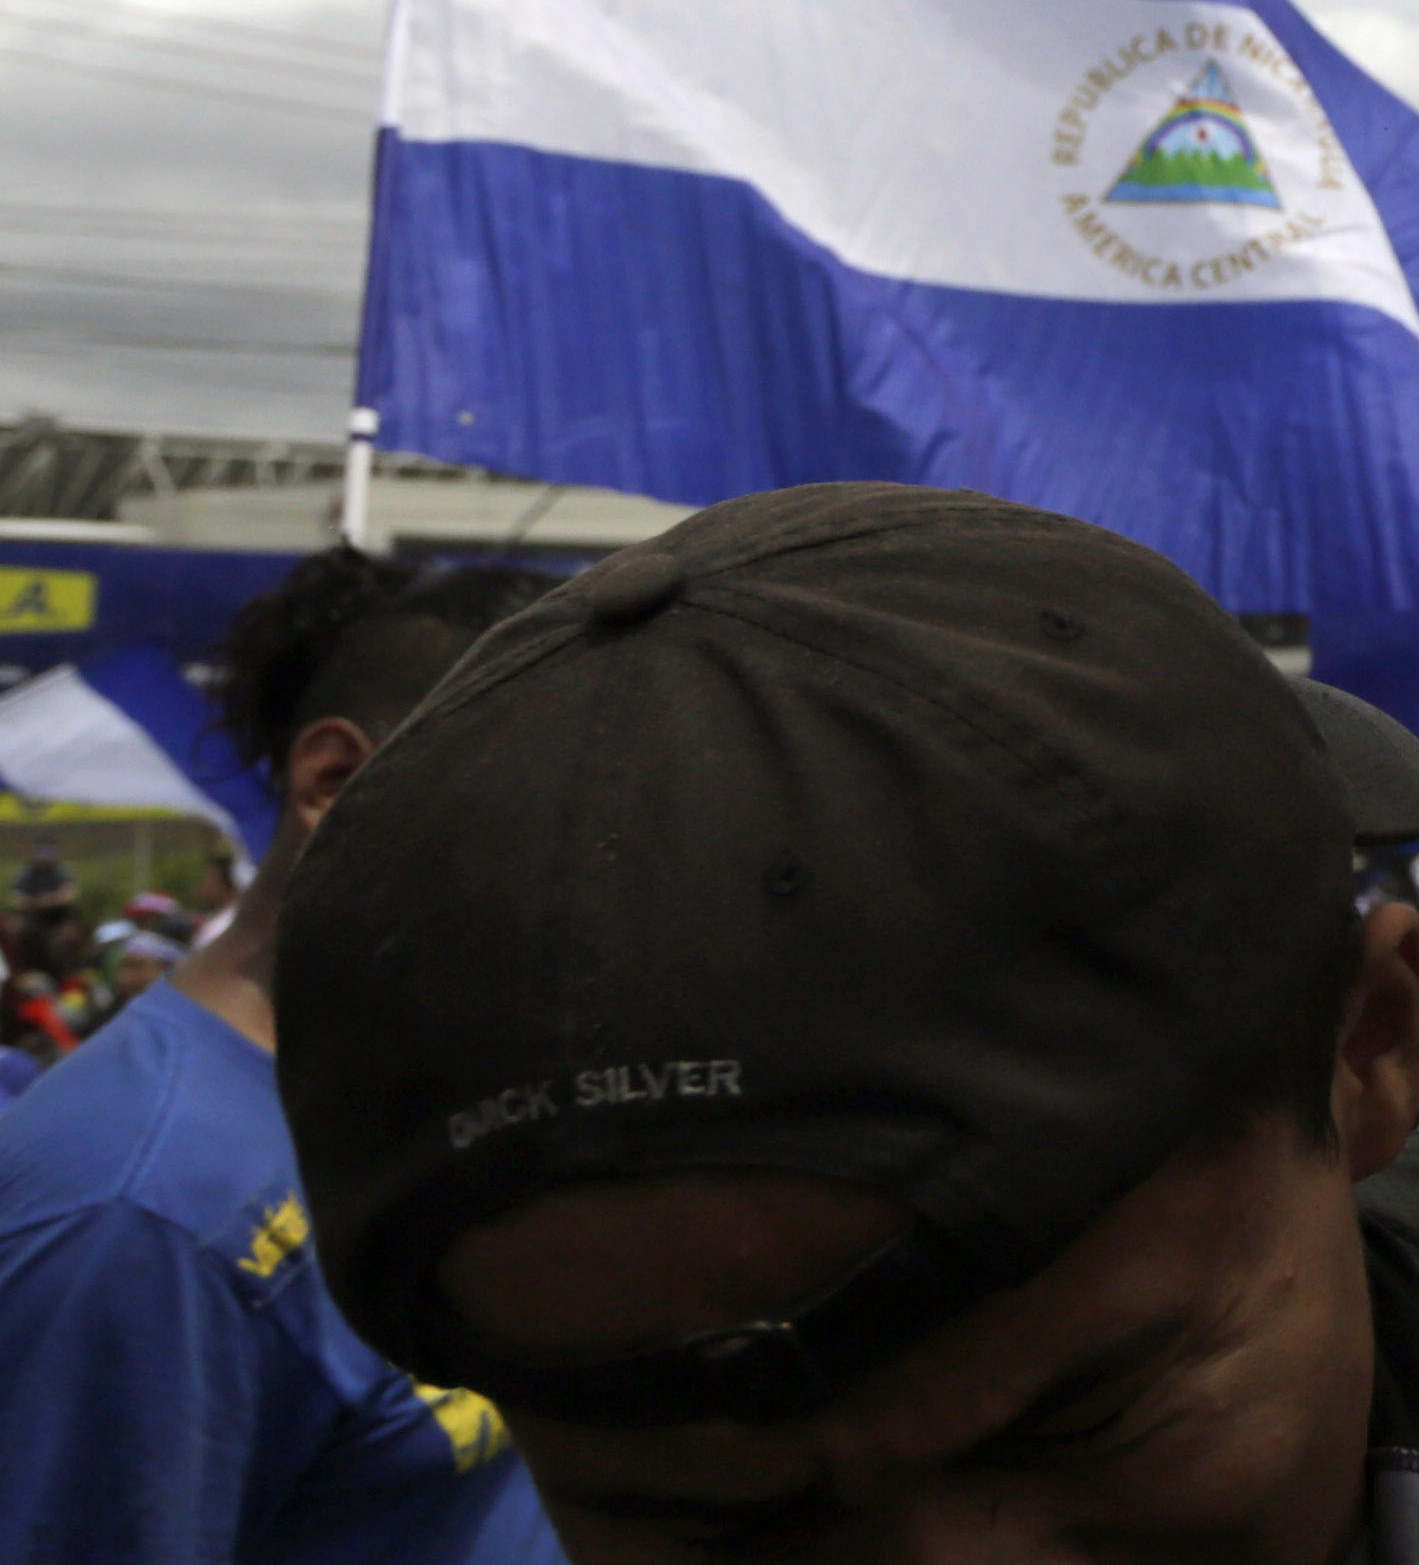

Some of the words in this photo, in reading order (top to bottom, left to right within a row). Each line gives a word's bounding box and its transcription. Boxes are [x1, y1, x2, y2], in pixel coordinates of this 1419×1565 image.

[1051, 26, 1179, 167] REPUBLICA
[1184, 20, 1231, 52] DE
[1189, 211, 1326, 290] CENTRAL
[574, 1058, 744, 1107] SILVER
